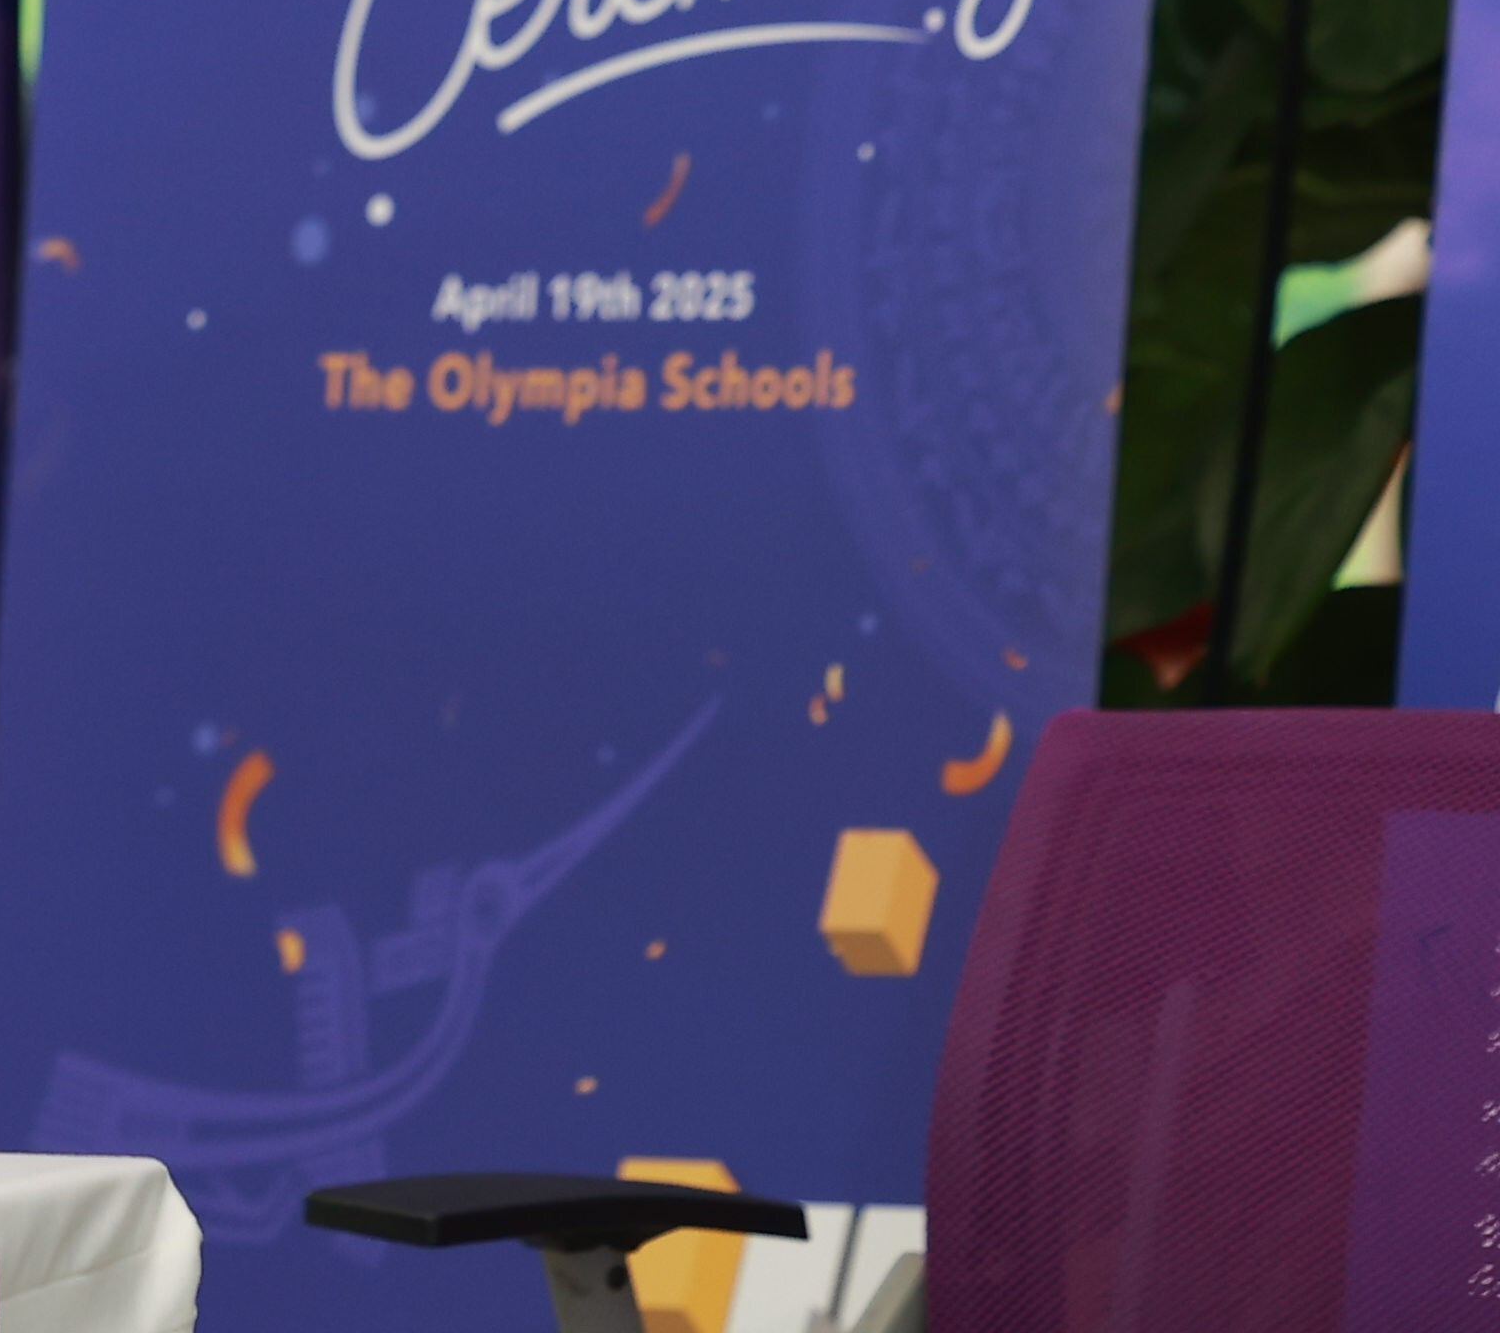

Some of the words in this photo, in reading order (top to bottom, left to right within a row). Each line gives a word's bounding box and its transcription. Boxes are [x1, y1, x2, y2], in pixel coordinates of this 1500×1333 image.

[434, 269, 539, 332] April
[549, 269, 641, 322] 19th
[649, 269, 754, 321] 2025
[319, 350, 412, 411] The
[426, 345, 647, 425] Olympia
[660, 346, 855, 411] Schools
